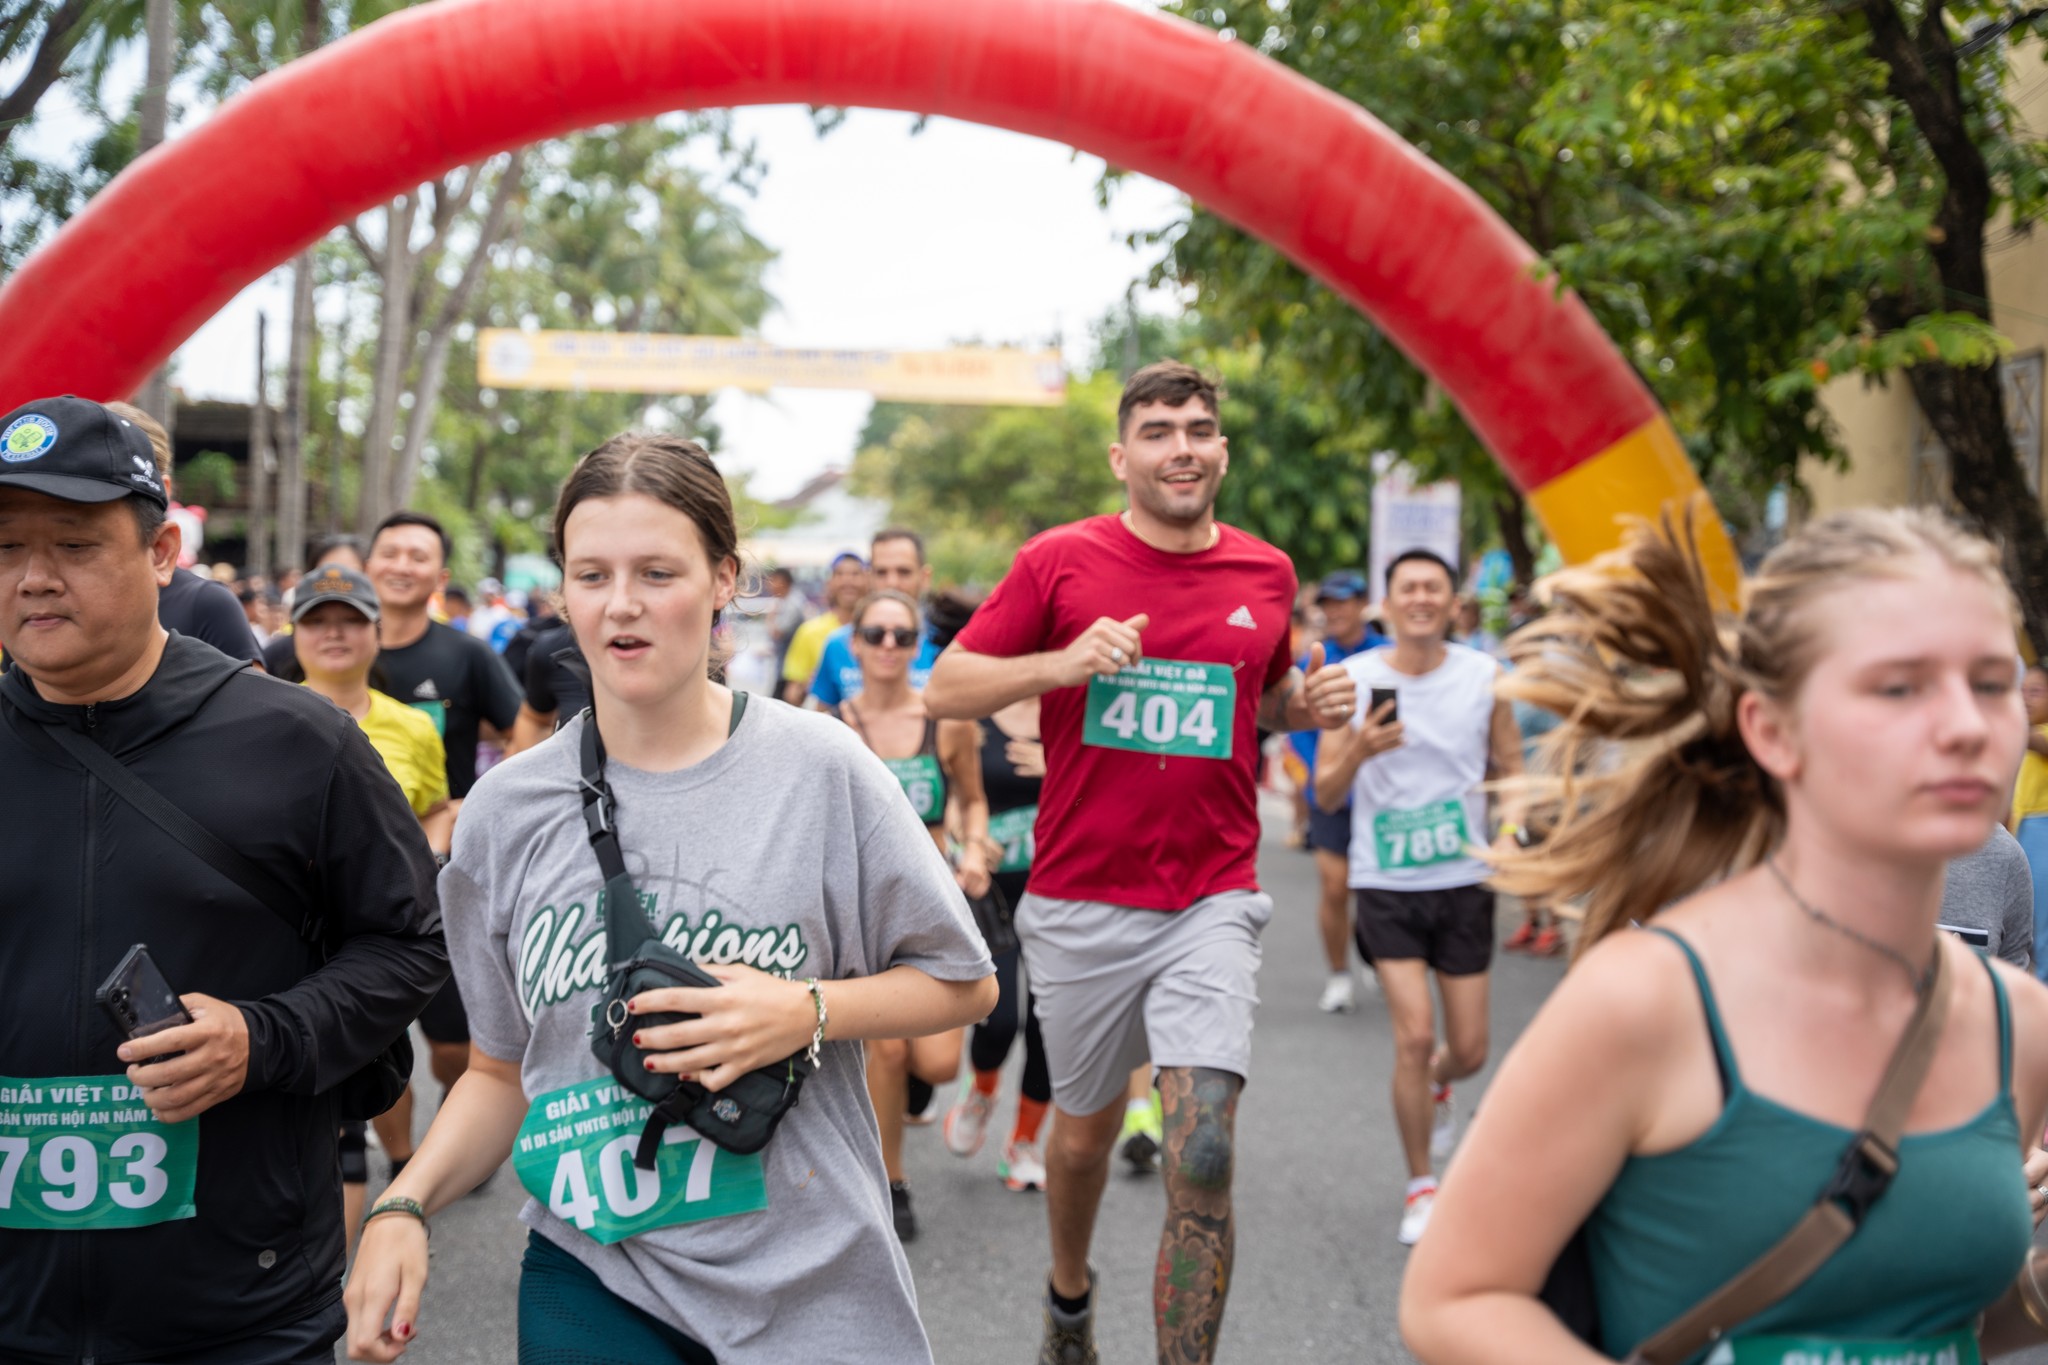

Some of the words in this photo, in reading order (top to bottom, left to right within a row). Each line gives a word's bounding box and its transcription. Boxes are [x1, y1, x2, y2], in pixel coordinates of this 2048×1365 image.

[1101, 691, 1218, 747] 404
[1384, 822, 1461, 865] 786
[0, 1084, 43, 1104] GIẢI
[50, 1084, 104, 1106] VIỆT
[546, 1091, 590, 1120] GIẢI
[23, 1112, 58, 1126] VHTG
[61, 1110, 86, 1128] HỘI
[88, 1111, 110, 1125] AN
[113, 1108, 148, 1123] NĂM
[533, 1132, 548, 1149] DI
[549, 1124, 573, 1144] SẢN
[574, 1115, 610, 1135] VHTG
[612, 1106, 635, 1127] HỘI
[0, 1132, 169, 1212] 793
[549, 1126, 720, 1230] 407
